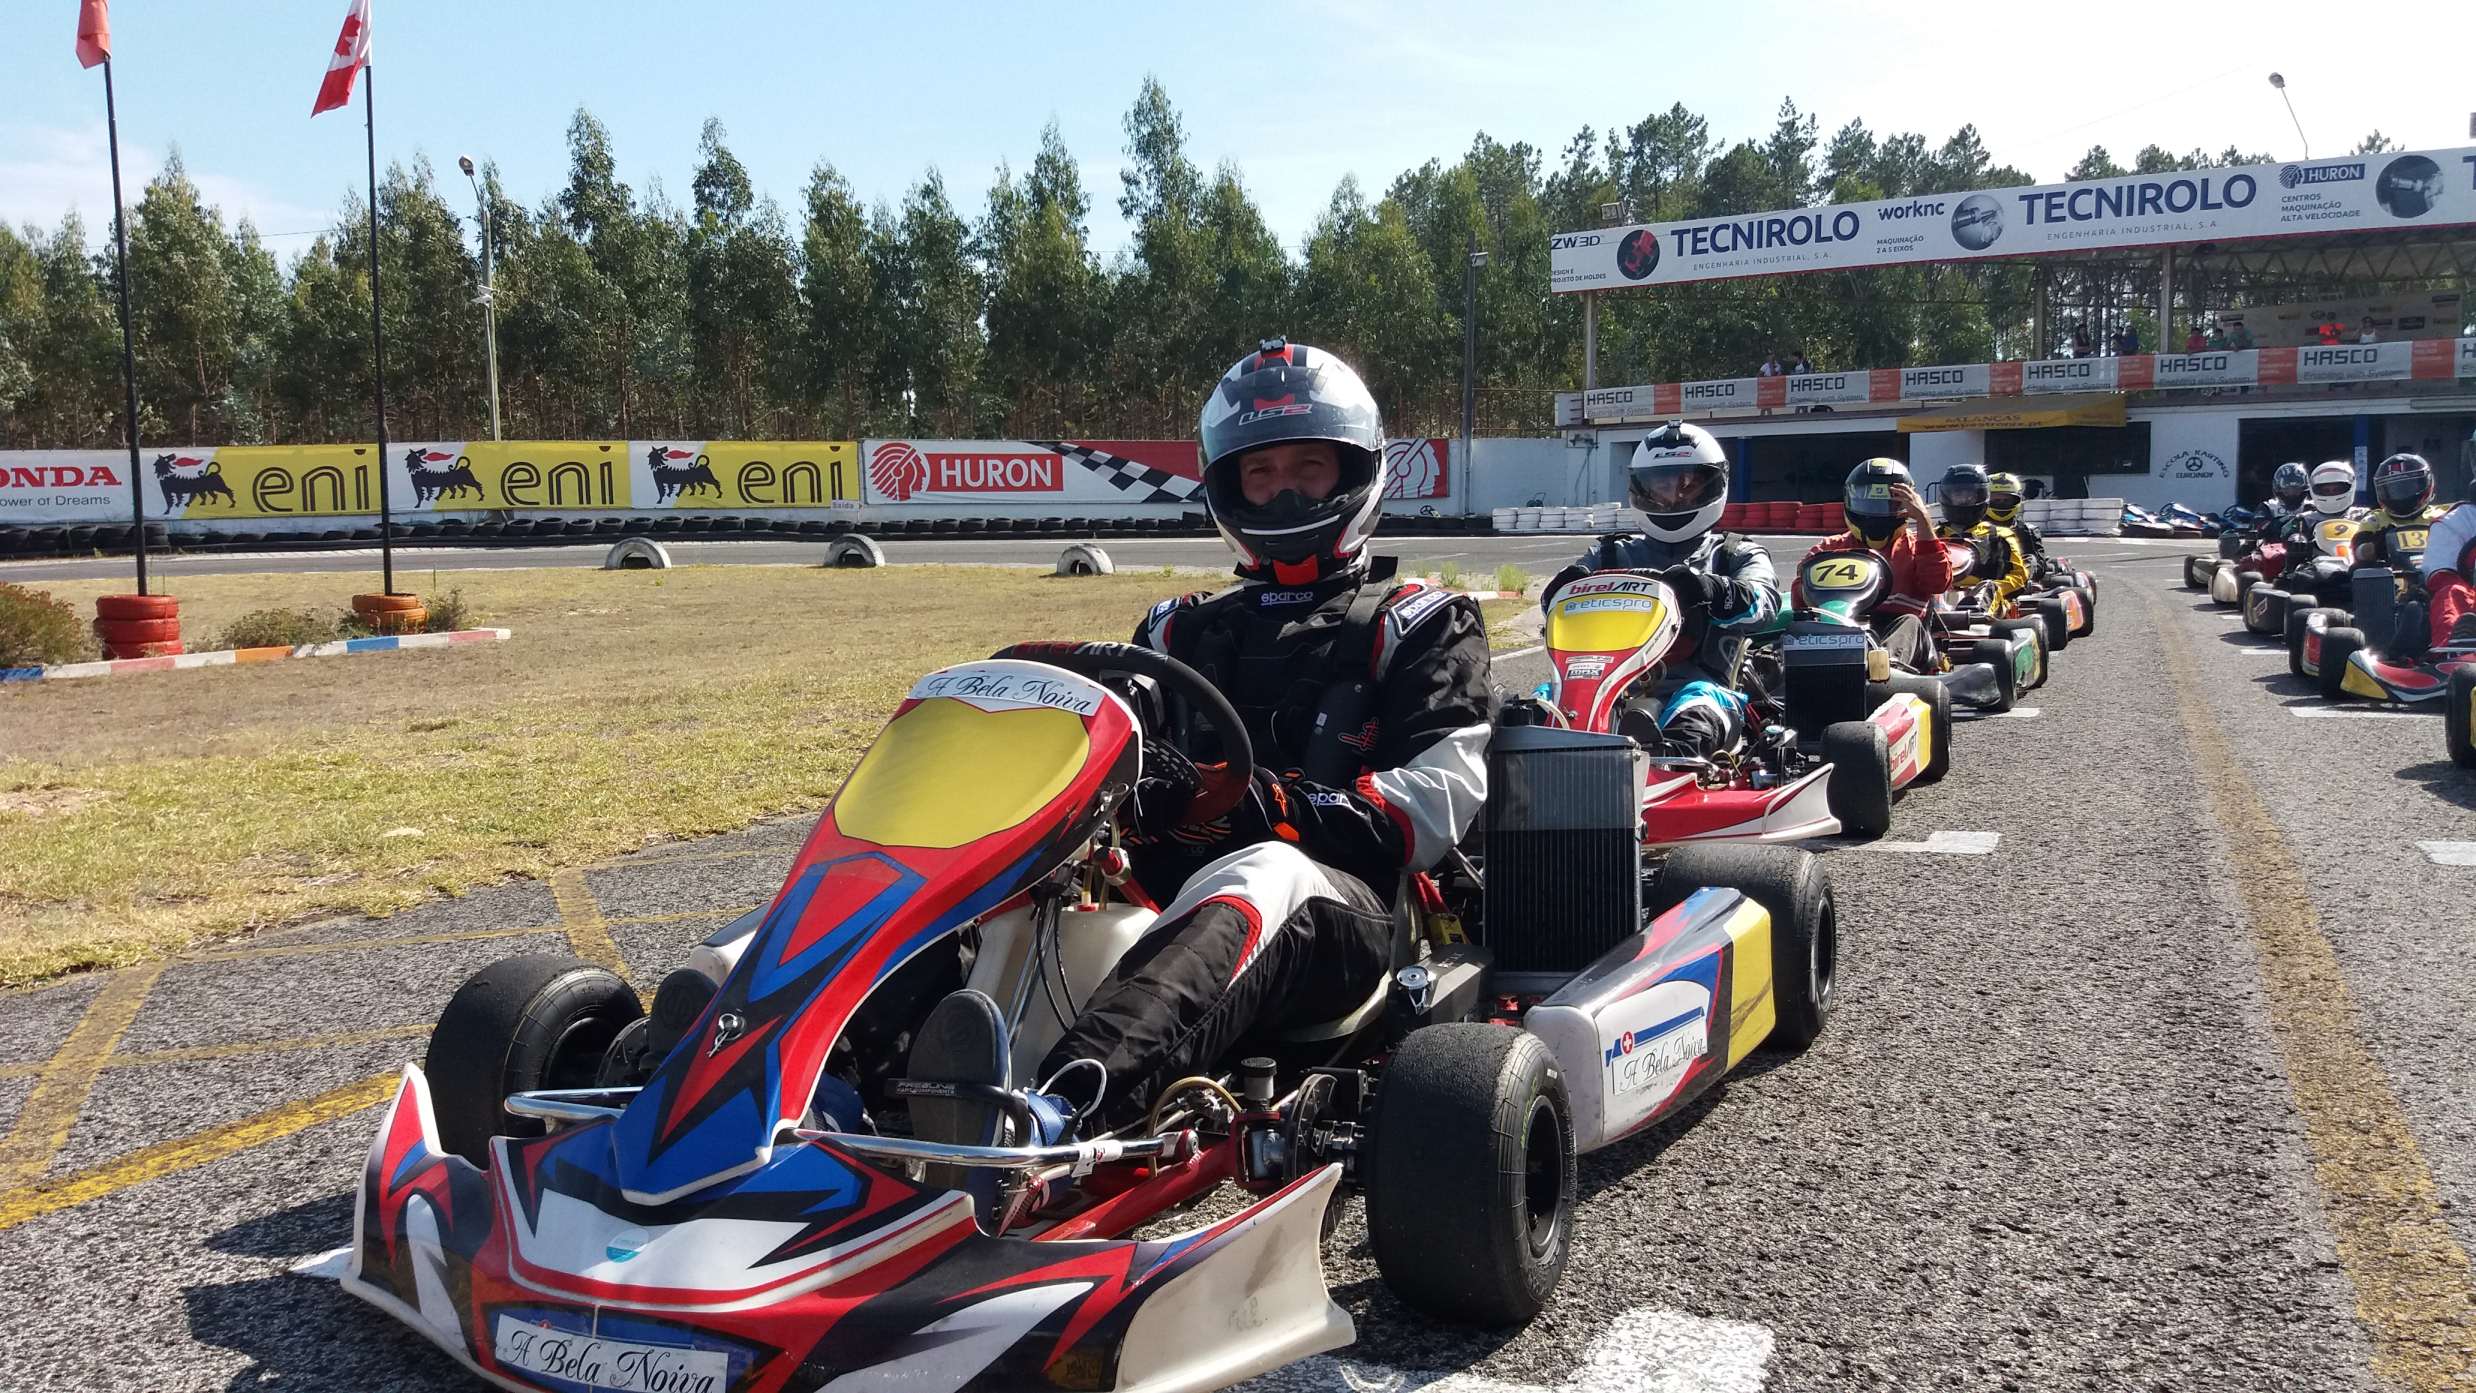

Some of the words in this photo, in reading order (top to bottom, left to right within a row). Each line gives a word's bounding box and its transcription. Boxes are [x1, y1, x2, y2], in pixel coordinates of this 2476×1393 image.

[2309, 165, 2360, 181] HURON
[2018, 173, 2257, 226] TECNIROLO
[2281, 193, 2321, 203] CENTROS
[2280, 214, 2303, 222] ALTA
[2305, 209, 2361, 220] VELOCIDADE
[1670, 210, 1860, 257] TECNIROLO
[2047, 228, 2117, 240] ENGENHARIA
[1693, 259, 1749, 271] ENGENHARIA
[2159, 356, 2227, 373] HASCO
[2304, 348, 2378, 366] HASCO
[1905, 370, 1964, 386] HASCO
[2028, 363, 2090, 379] HASCO
[1685, 383, 1735, 399] HASCO
[1790, 376, 1845, 392] HASCO
[1587, 391, 1633, 405] HASCO
[252, 448, 370, 513] eni
[500, 445, 614, 506] eni
[737, 445, 843, 504] eni
[940, 458, 1052, 488] HURON
[37, 496, 51, 506] of
[55, 494, 112, 507] Dreams
[2334, 525, 2349, 536] 9
[1815, 564, 1859, 582] 74
[1567, 581, 1653, 595] birelART
[924, 675, 955, 697] A
[954, 674, 1014, 697] Bela
[1018, 679, 1093, 714] Noiva
[1620, 1058, 1639, 1091] A
[1641, 1041, 1670, 1080] Bela
[1671, 1031, 1707, 1068] Noiva
[506, 1329, 537, 1365] A
[539, 1338, 602, 1385] Bela
[611, 1348, 716, 1393] Noiva
